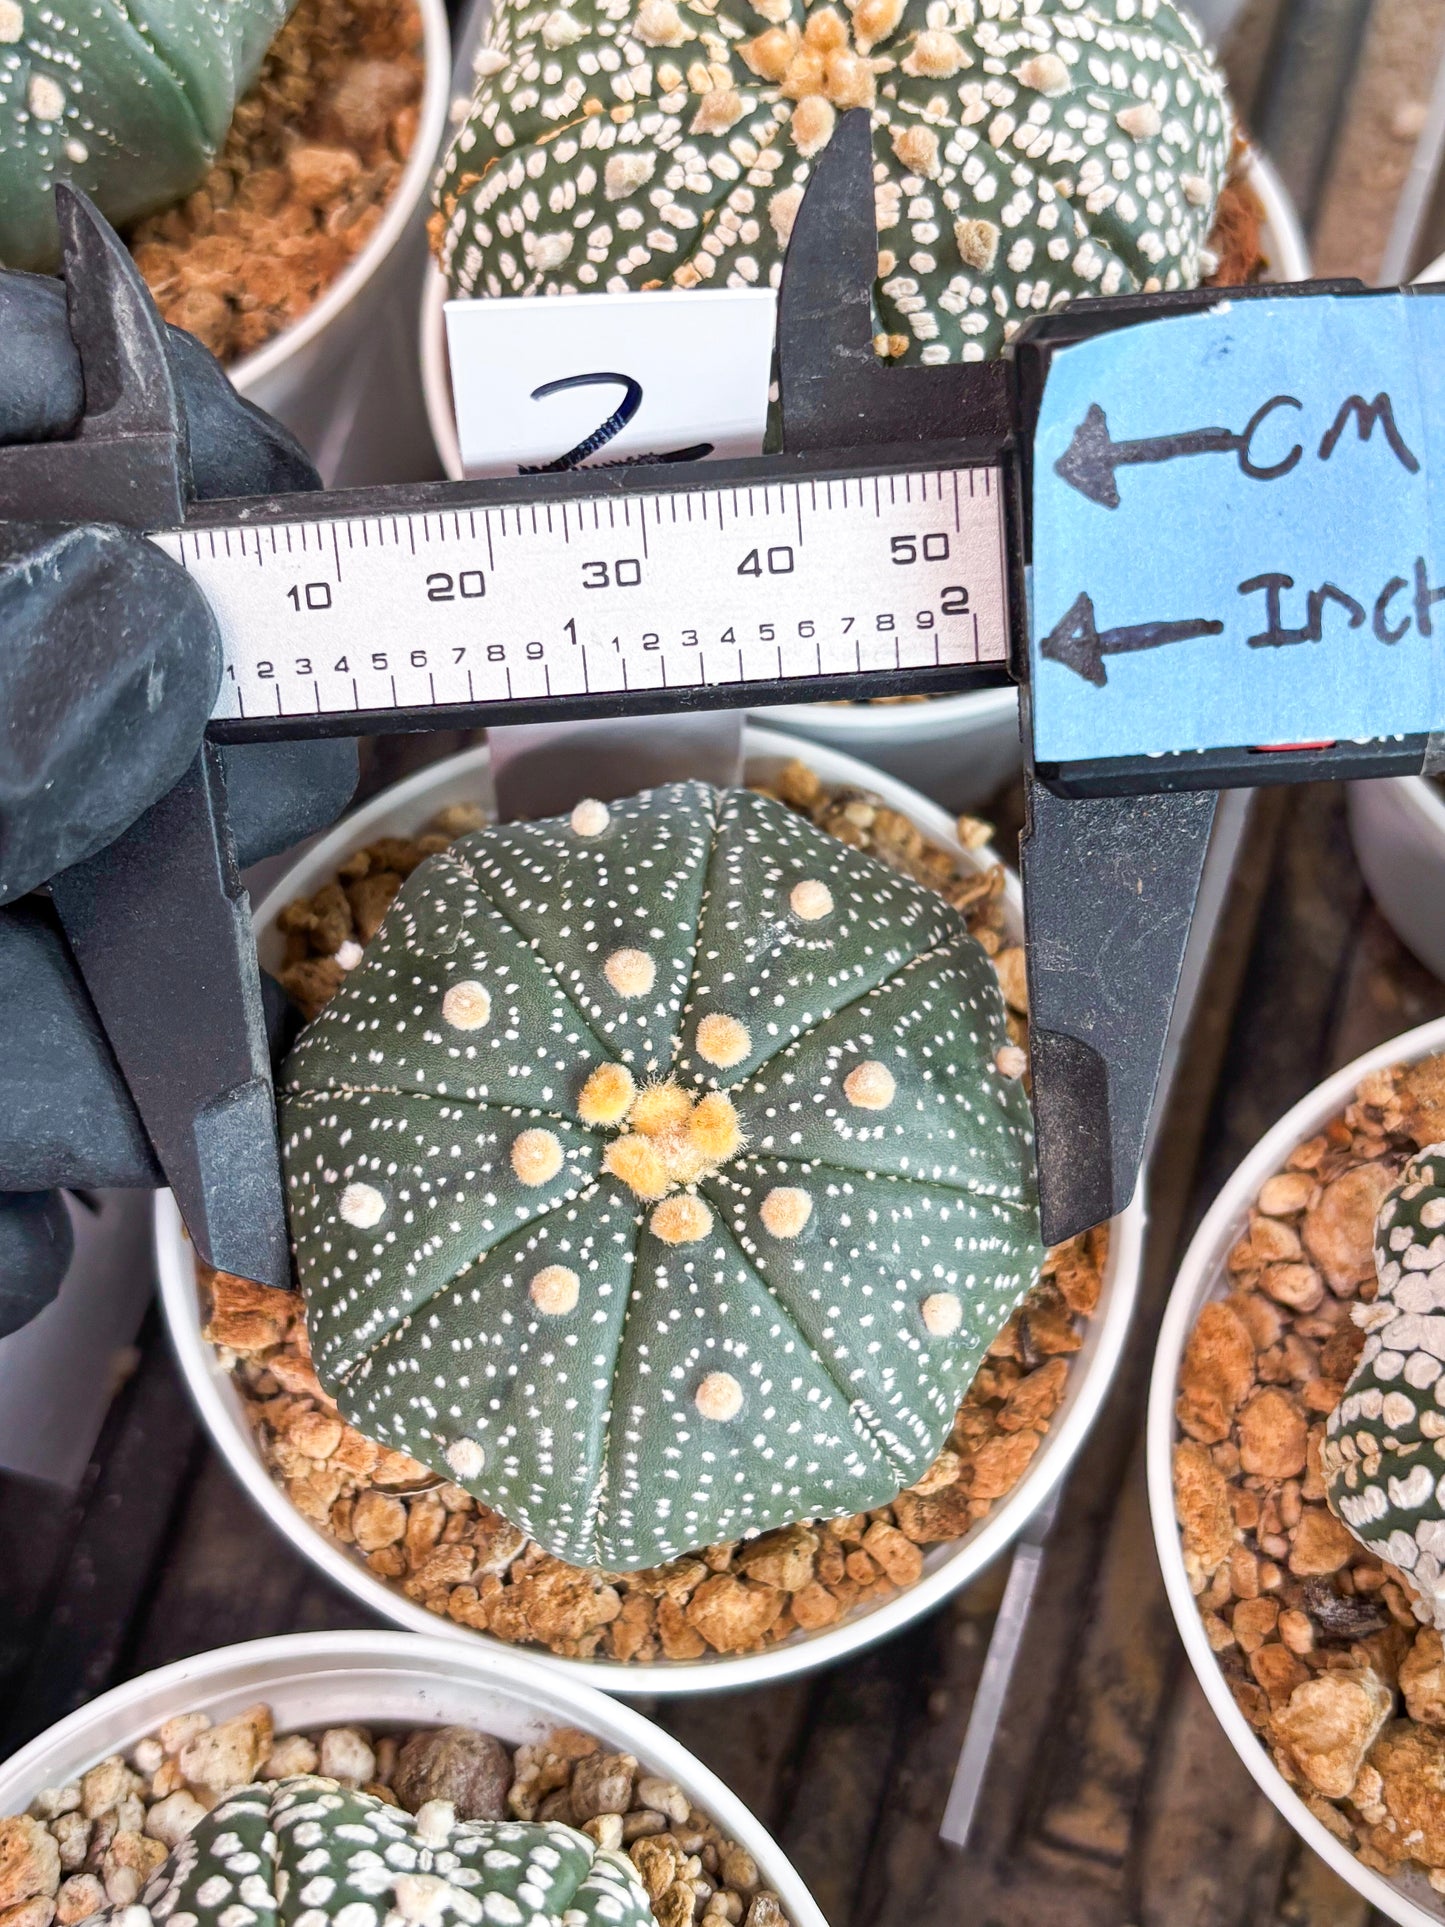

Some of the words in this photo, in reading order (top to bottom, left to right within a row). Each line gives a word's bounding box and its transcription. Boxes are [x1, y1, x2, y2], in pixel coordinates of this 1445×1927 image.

[286, 582, 332, 612] 10
[426, 570, 486, 602] 20
[581, 558, 642, 589] 30
[737, 545, 795, 578] 40
[890, 532, 950, 565] 50
[226, 664, 236, 681] 1
[256, 660, 275, 679] 2
[295, 658, 313, 675] 3
[334, 655, 350, 673] 4
[371, 652, 388, 671] 5
[410, 650, 428, 668] 6
[452, 647, 466, 664] 7
[486, 644, 506, 662] 8
[526, 641, 544, 661] 9
[563, 617, 577, 645] 1
[612, 636, 620, 653] 1
[642, 632, 660, 651] 2
[681, 629, 699, 647] 3
[720, 626, 736, 644] 4
[759, 623, 775, 641] 5
[798, 620, 815, 638] 6
[841, 617, 855, 634] 7
[876, 613, 895, 632] 8
[916, 610, 935, 630] 9
[940, 585, 970, 616] 2
